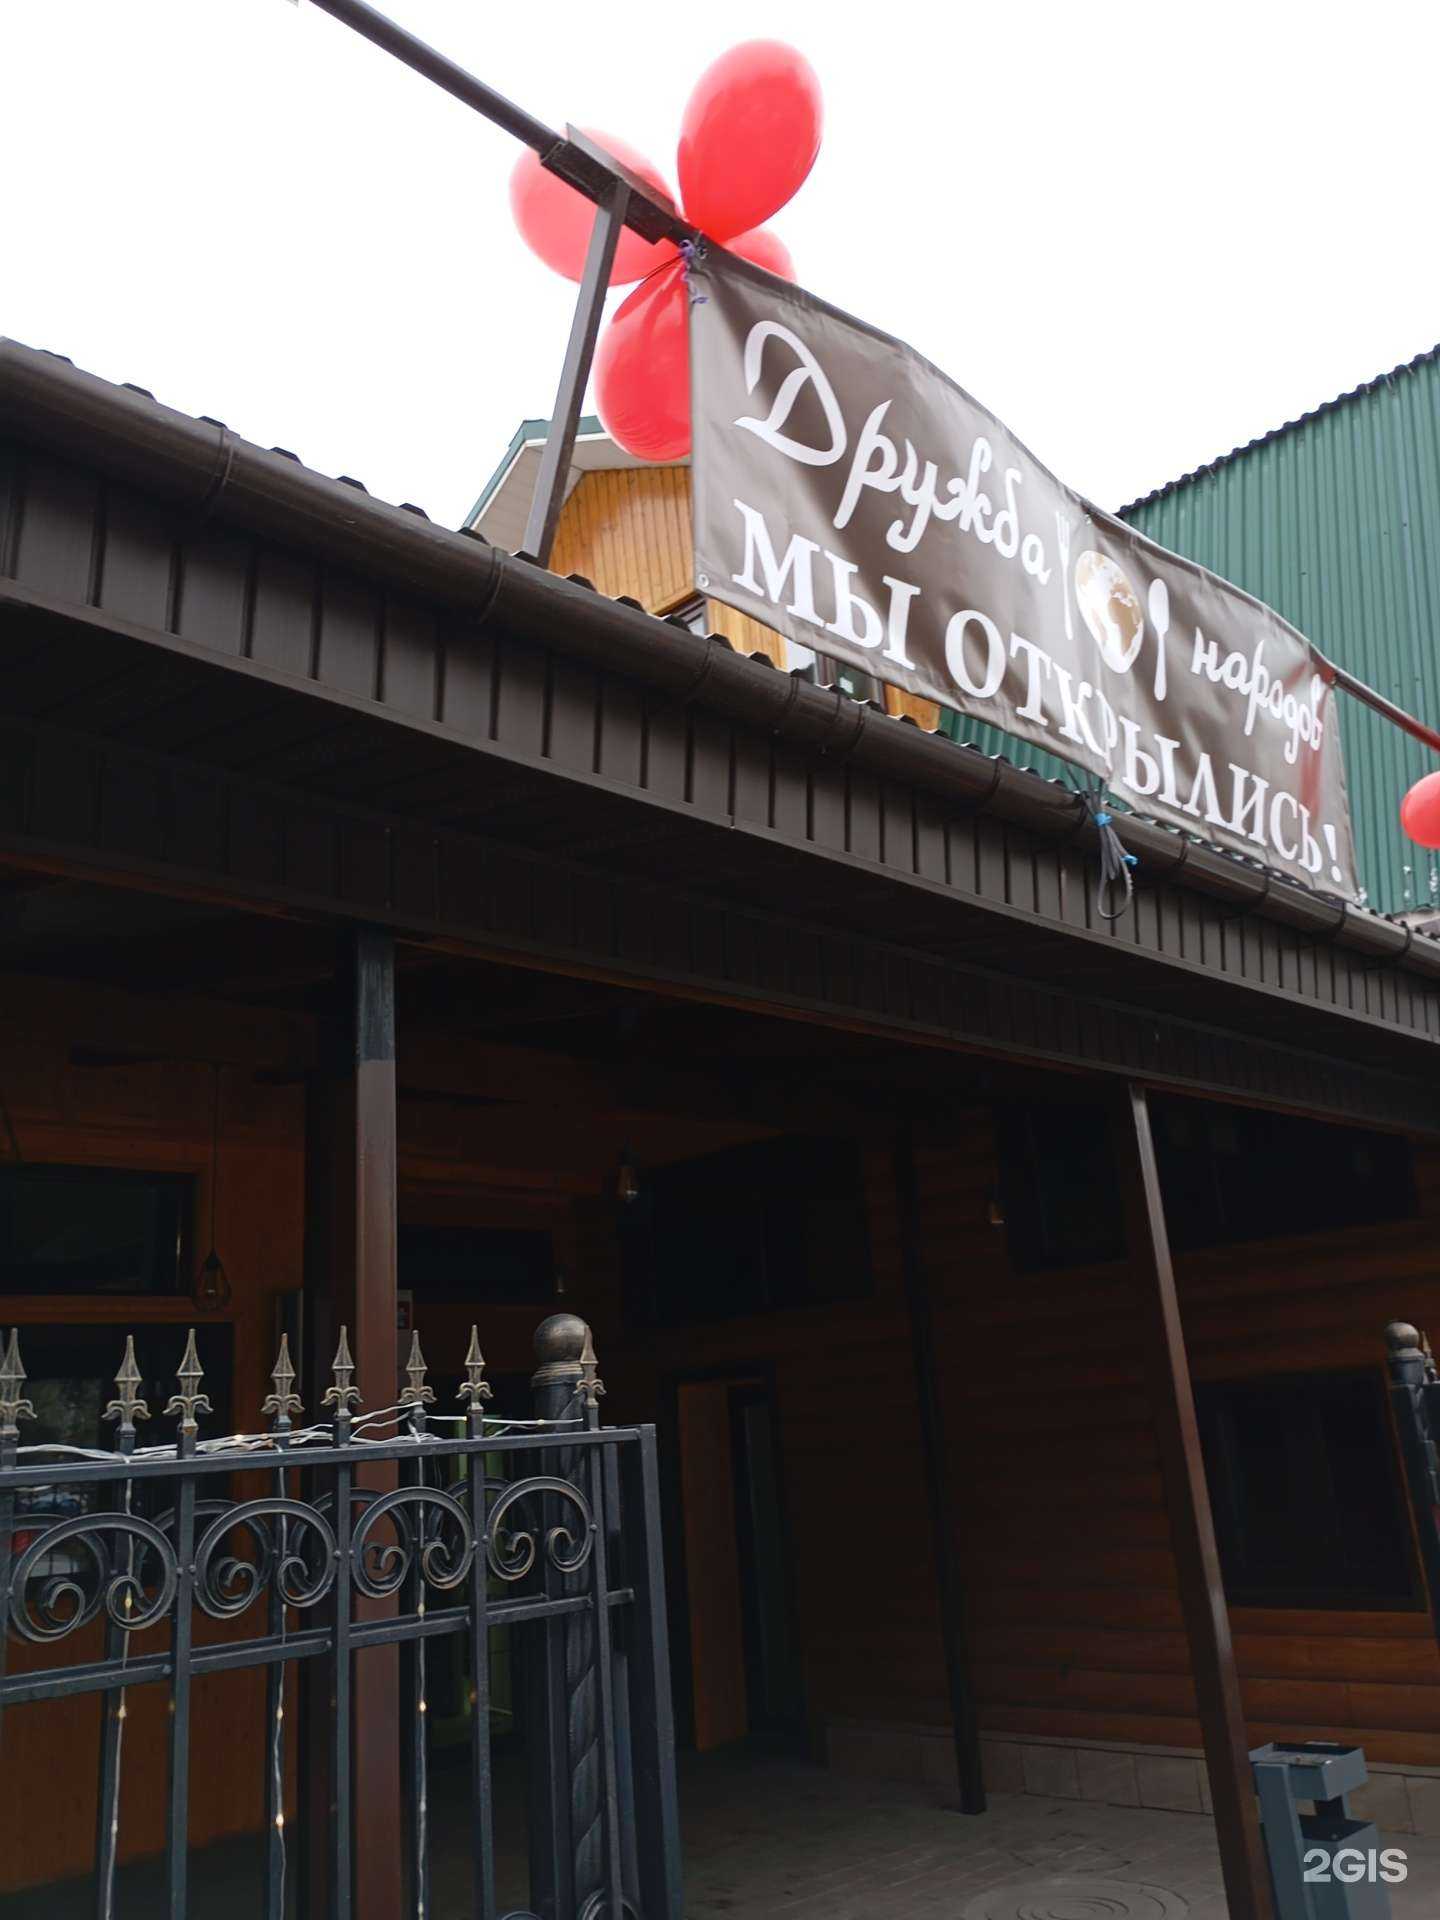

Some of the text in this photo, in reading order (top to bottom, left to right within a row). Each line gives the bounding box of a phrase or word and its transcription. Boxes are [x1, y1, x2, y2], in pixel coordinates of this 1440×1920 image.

[731, 498, 1342, 883] МЫ ОТКРЫЛИСЬ!
[733, 320, 1323, 765] Дружба народов
